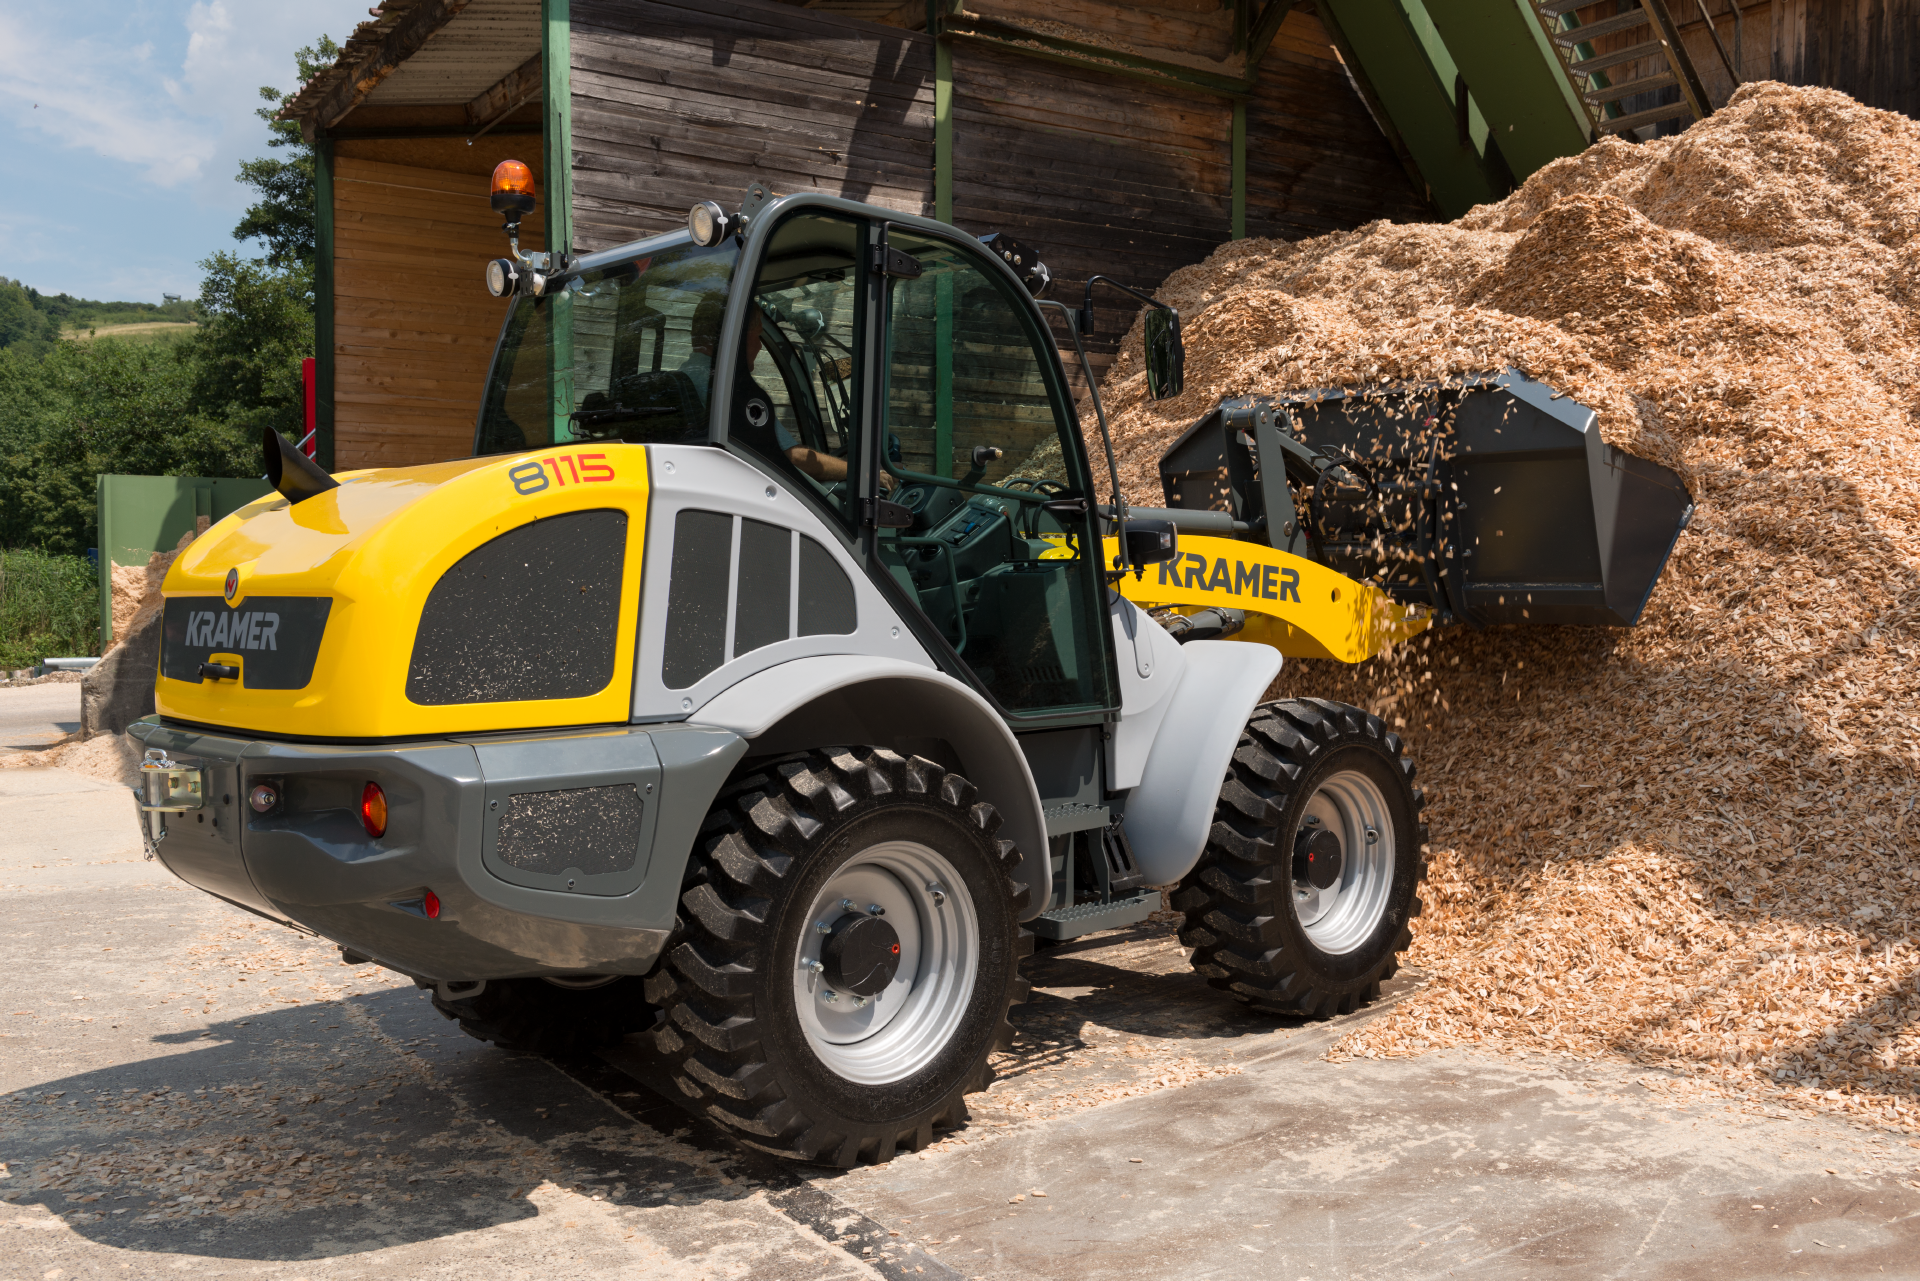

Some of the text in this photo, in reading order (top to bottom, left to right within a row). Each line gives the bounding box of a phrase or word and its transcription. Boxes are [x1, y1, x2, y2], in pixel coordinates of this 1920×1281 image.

[508, 453, 616, 496] 8115
[1158, 551, 1302, 604] KRAMER
[184, 610, 280, 651] KRAMER
